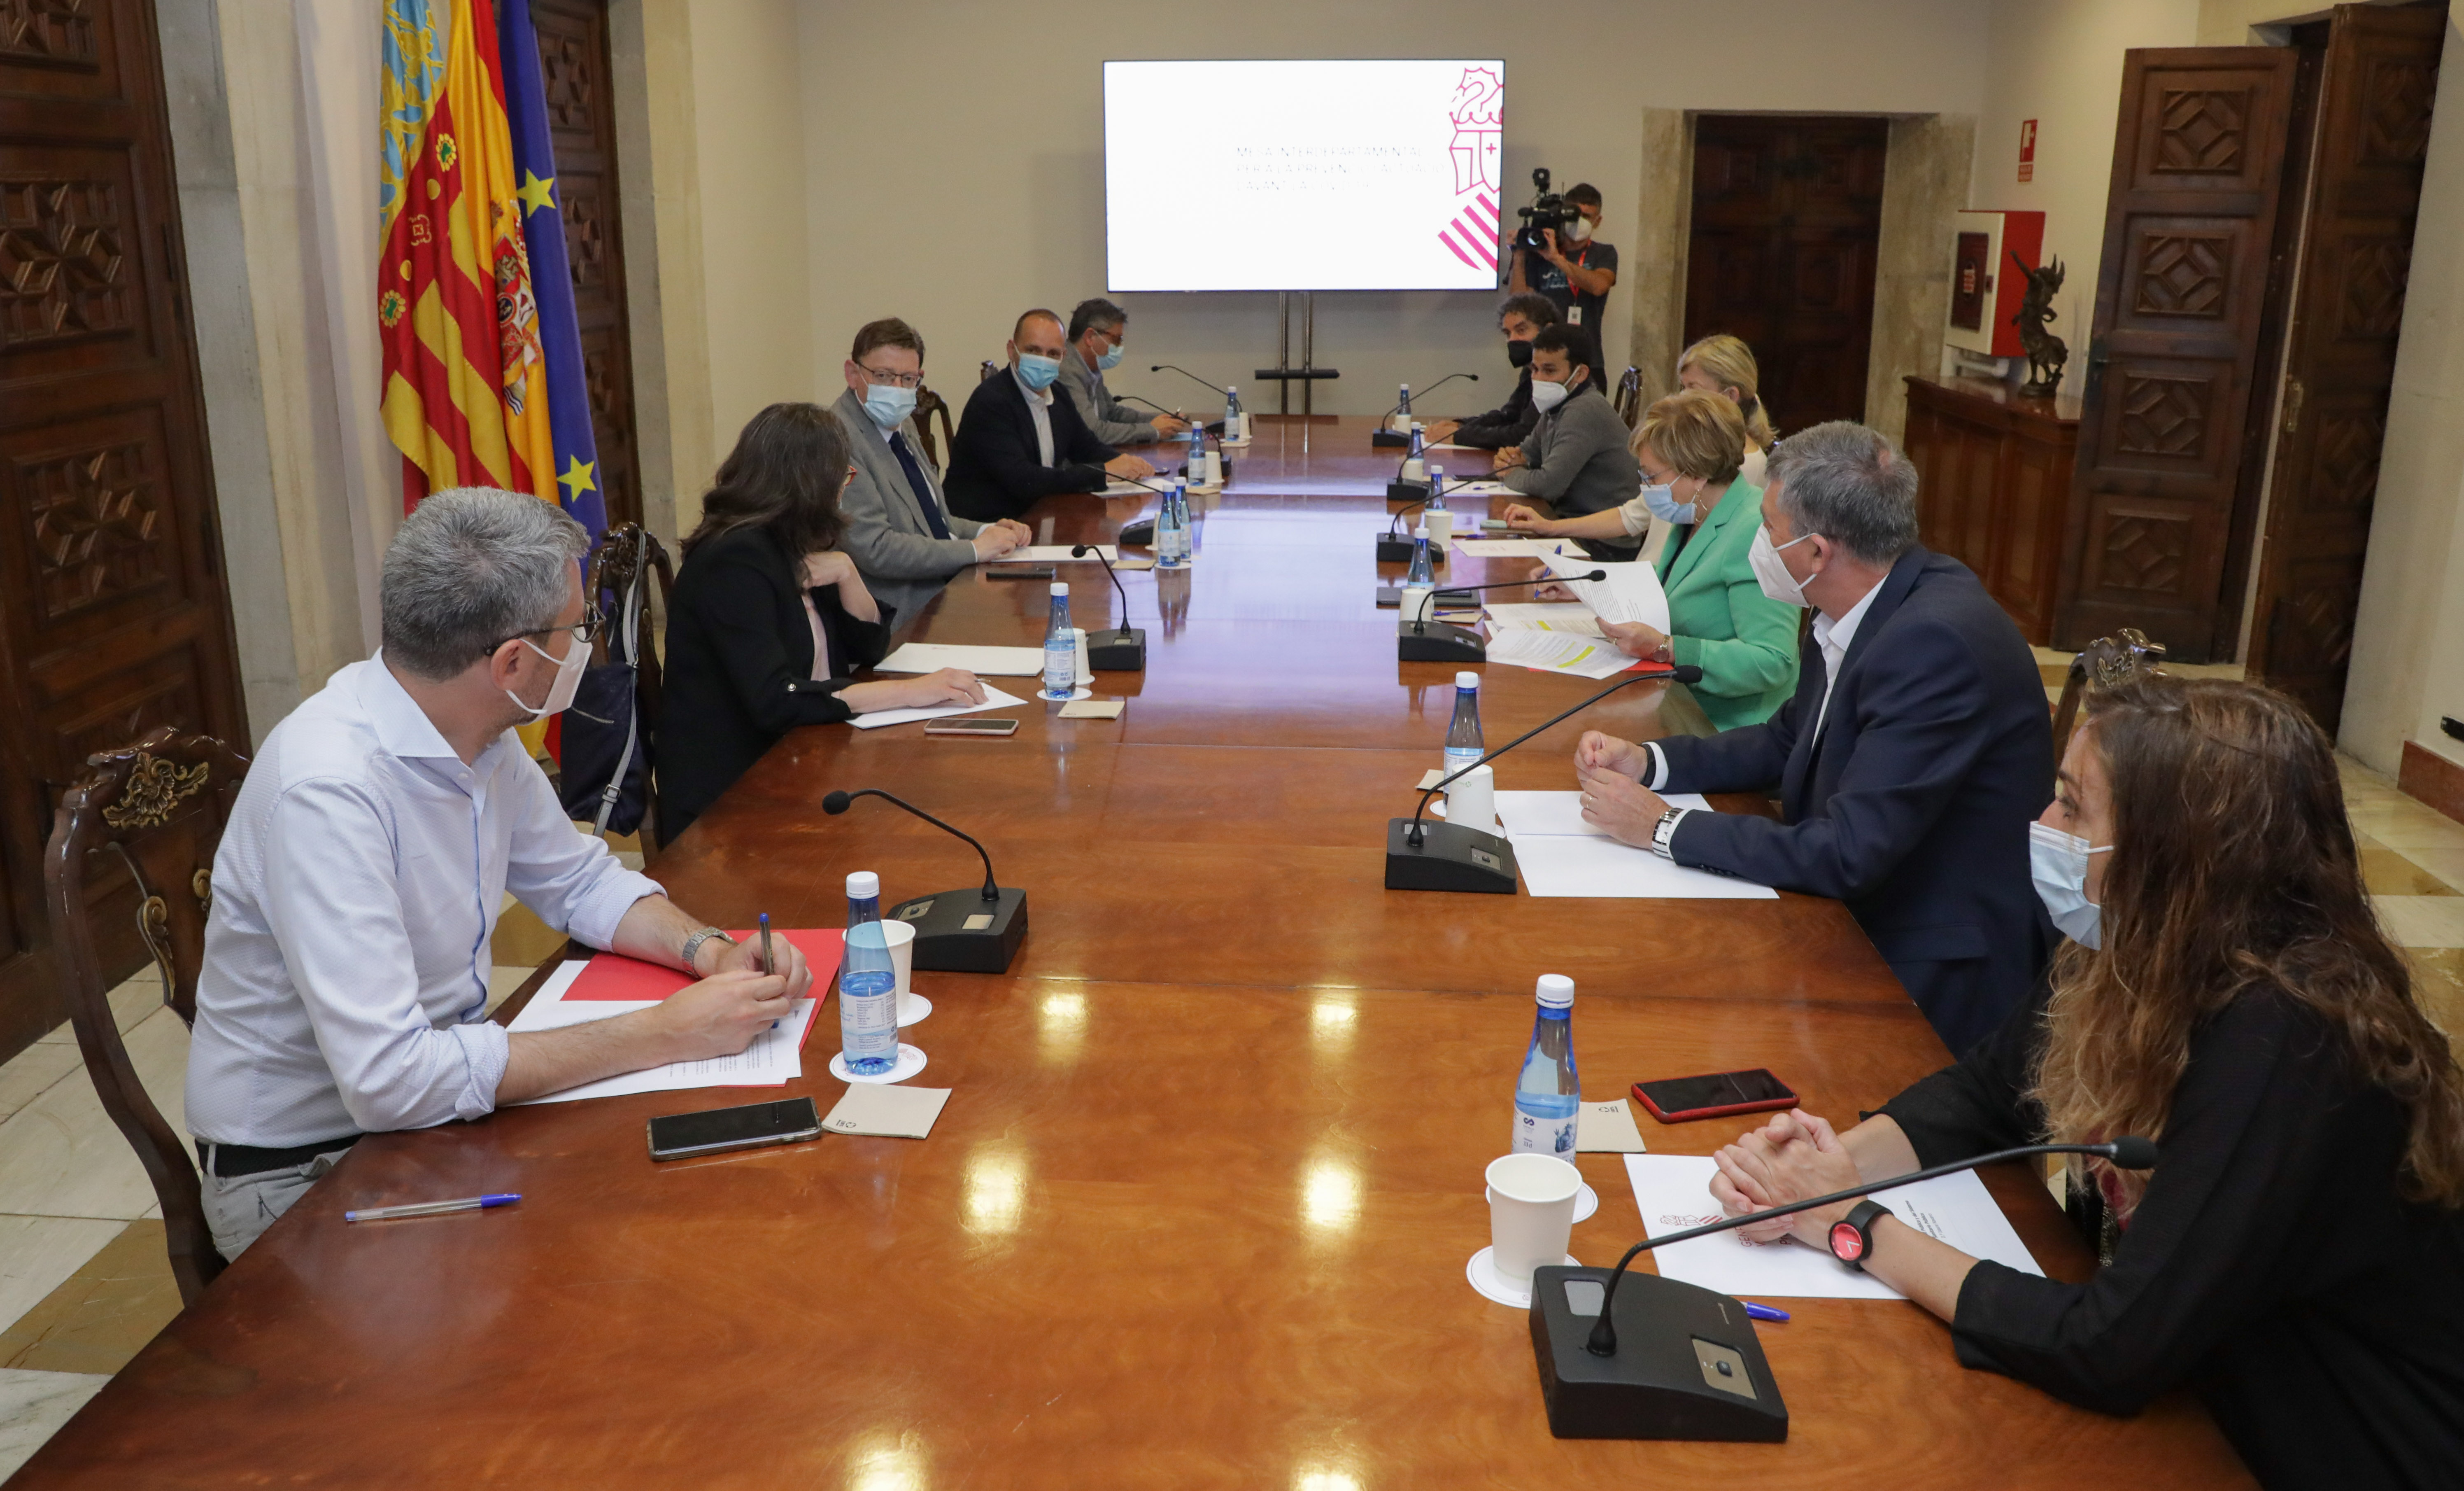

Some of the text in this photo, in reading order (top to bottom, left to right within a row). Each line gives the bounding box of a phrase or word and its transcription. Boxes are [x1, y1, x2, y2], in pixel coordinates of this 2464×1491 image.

[1237, 147, 1422, 157] MESA INTERDEPARTAMENTAL
[1265, 164, 1273, 173] A
